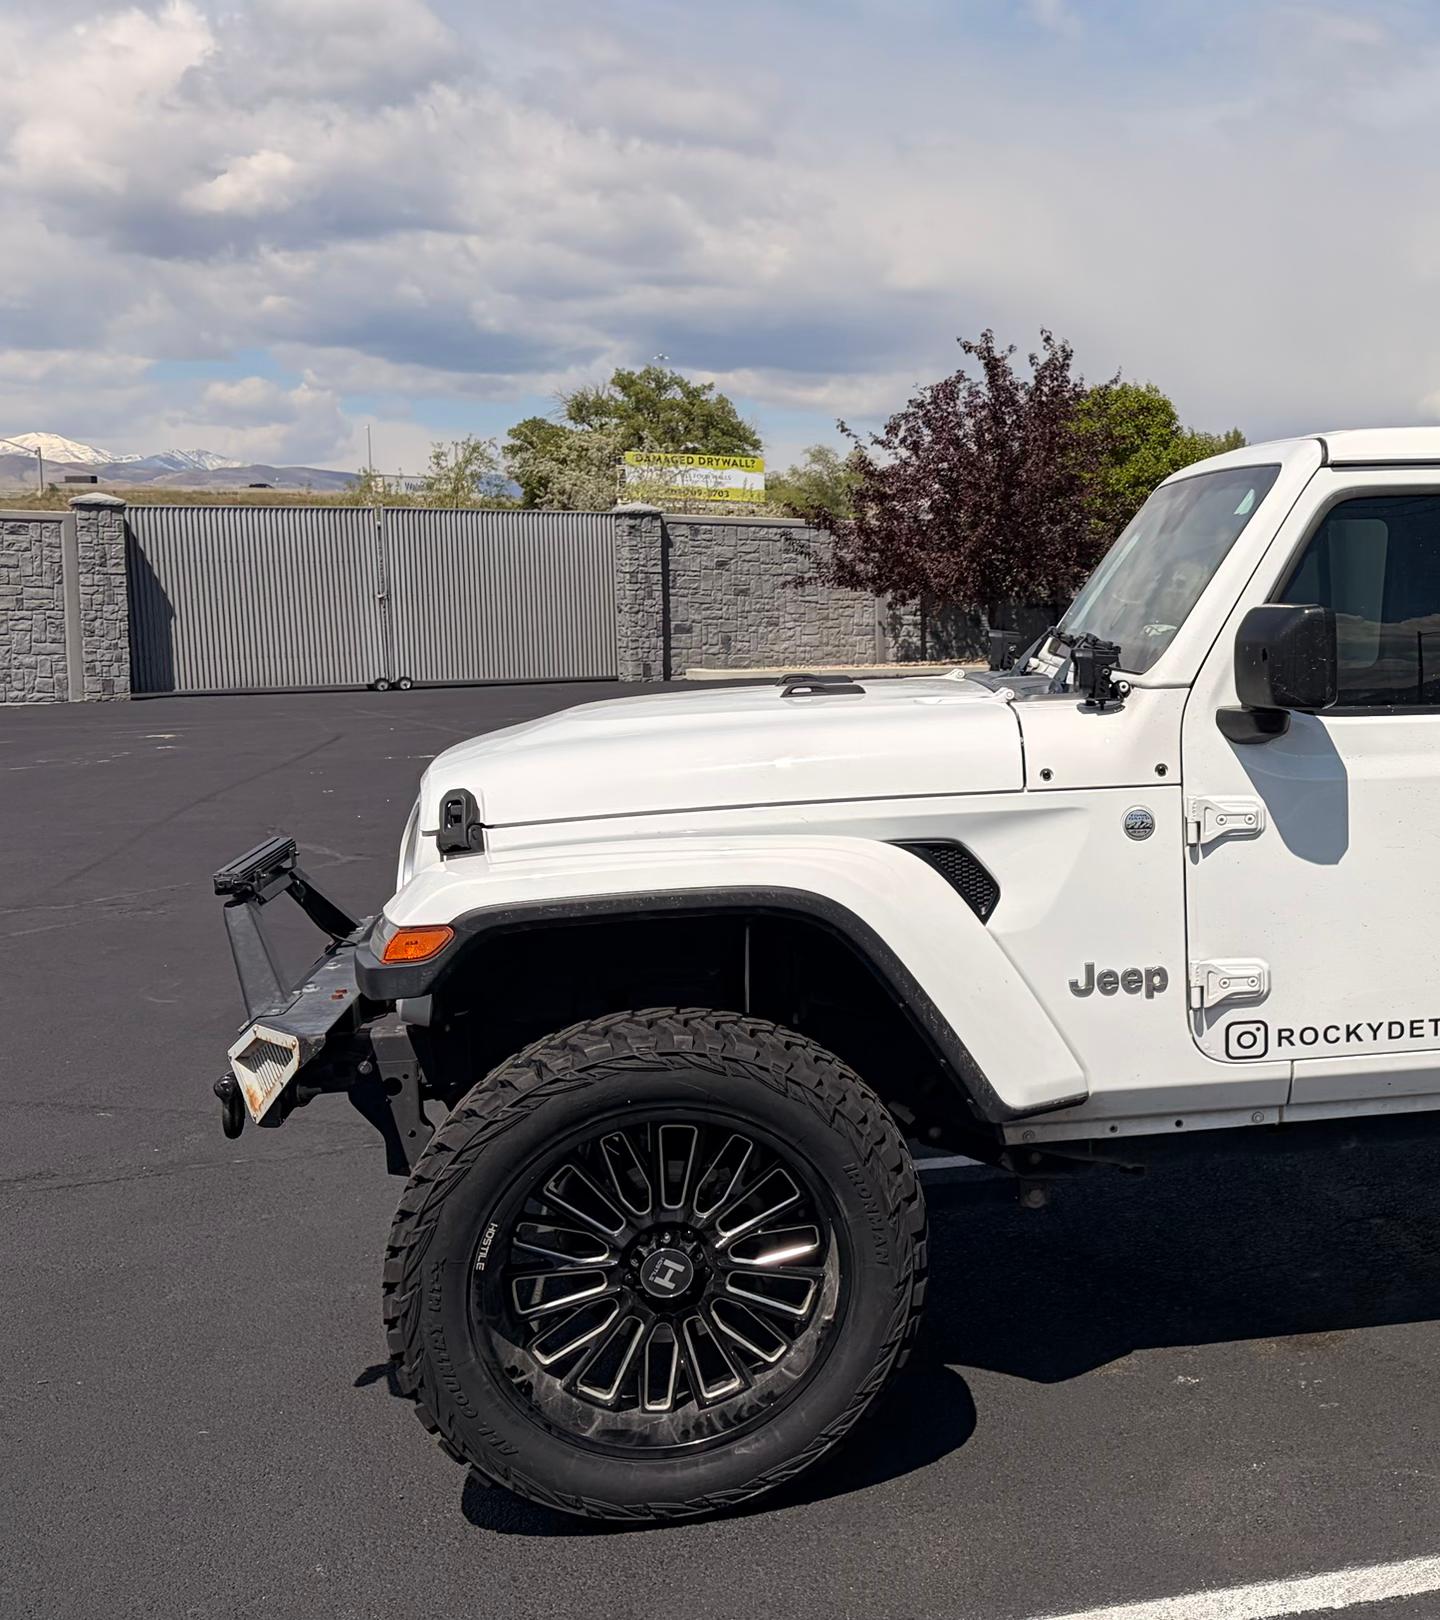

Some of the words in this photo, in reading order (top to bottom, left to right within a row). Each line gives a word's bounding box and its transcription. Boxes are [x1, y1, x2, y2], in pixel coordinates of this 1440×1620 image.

[634, 453, 694, 465] DAMAGED
[698, 456, 756, 469] DRYWALL?
[1068, 962, 1169, 1000] Jeep
[842, 1163, 890, 1266] IRONMAN
[475, 1222, 498, 1271] HOSTILE
